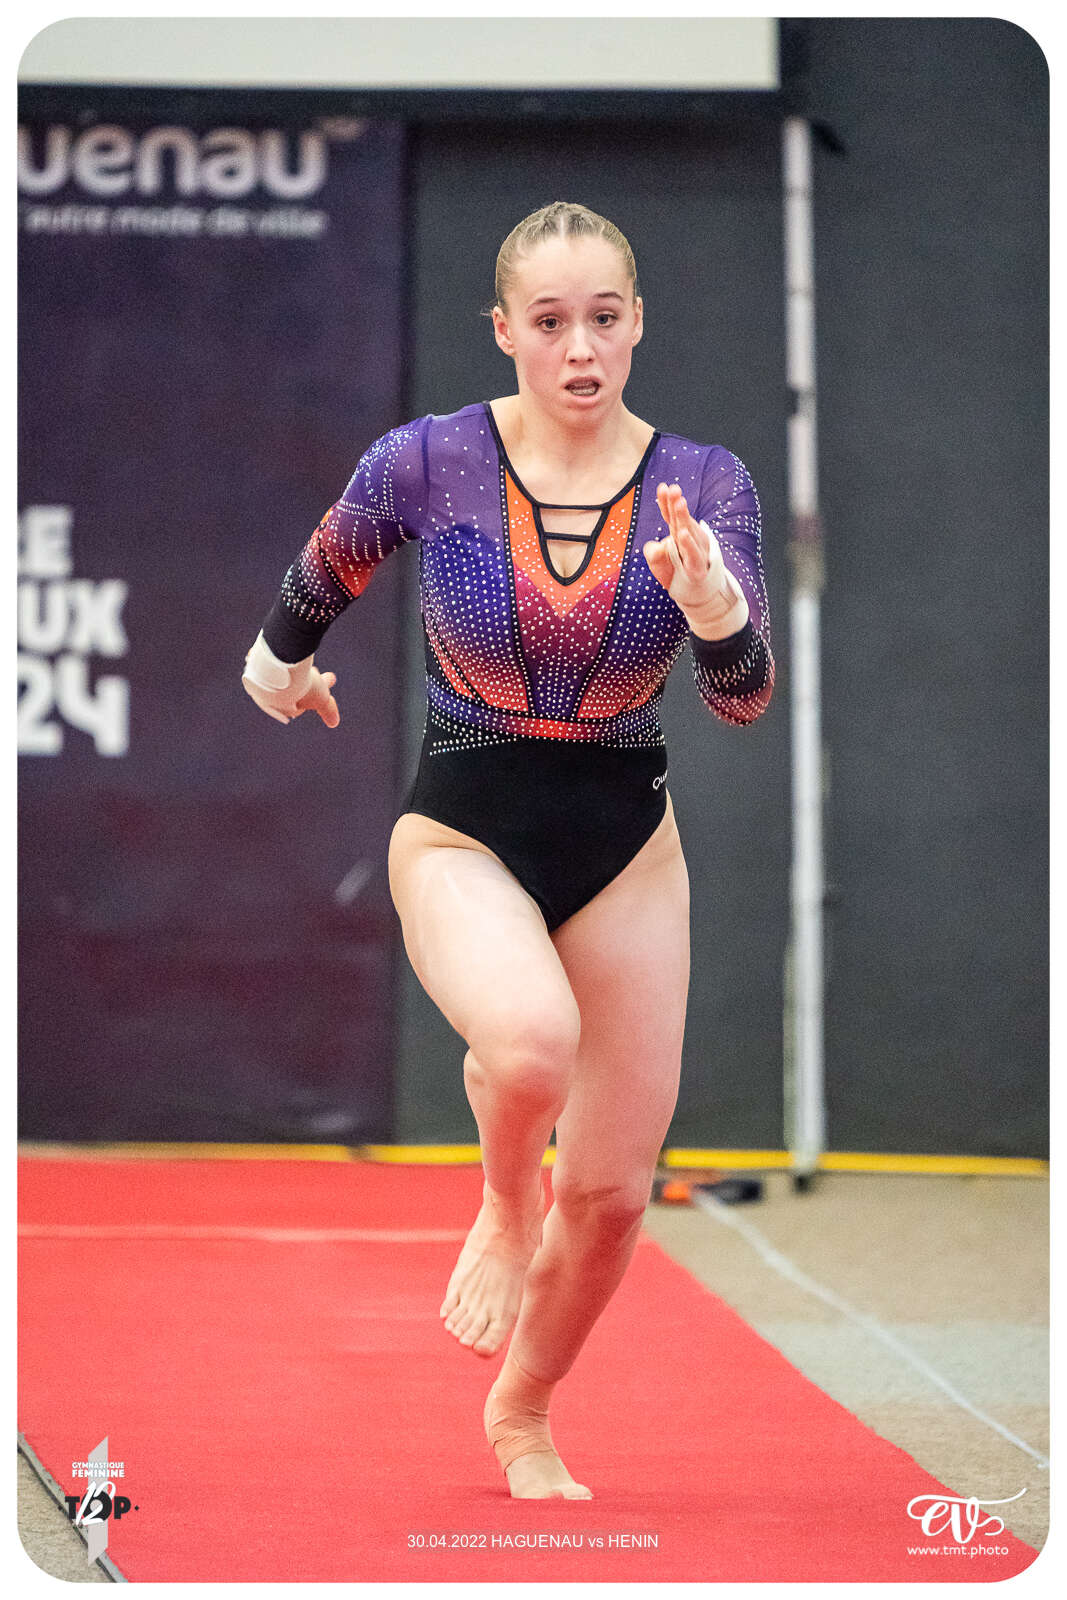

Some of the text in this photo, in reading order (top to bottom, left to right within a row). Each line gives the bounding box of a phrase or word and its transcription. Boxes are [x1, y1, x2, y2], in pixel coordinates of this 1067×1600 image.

[17, 123, 327, 199] uenau
[17, 504, 73, 576] E
[17, 579, 128, 659] UX
[17, 653, 131, 757] 24
